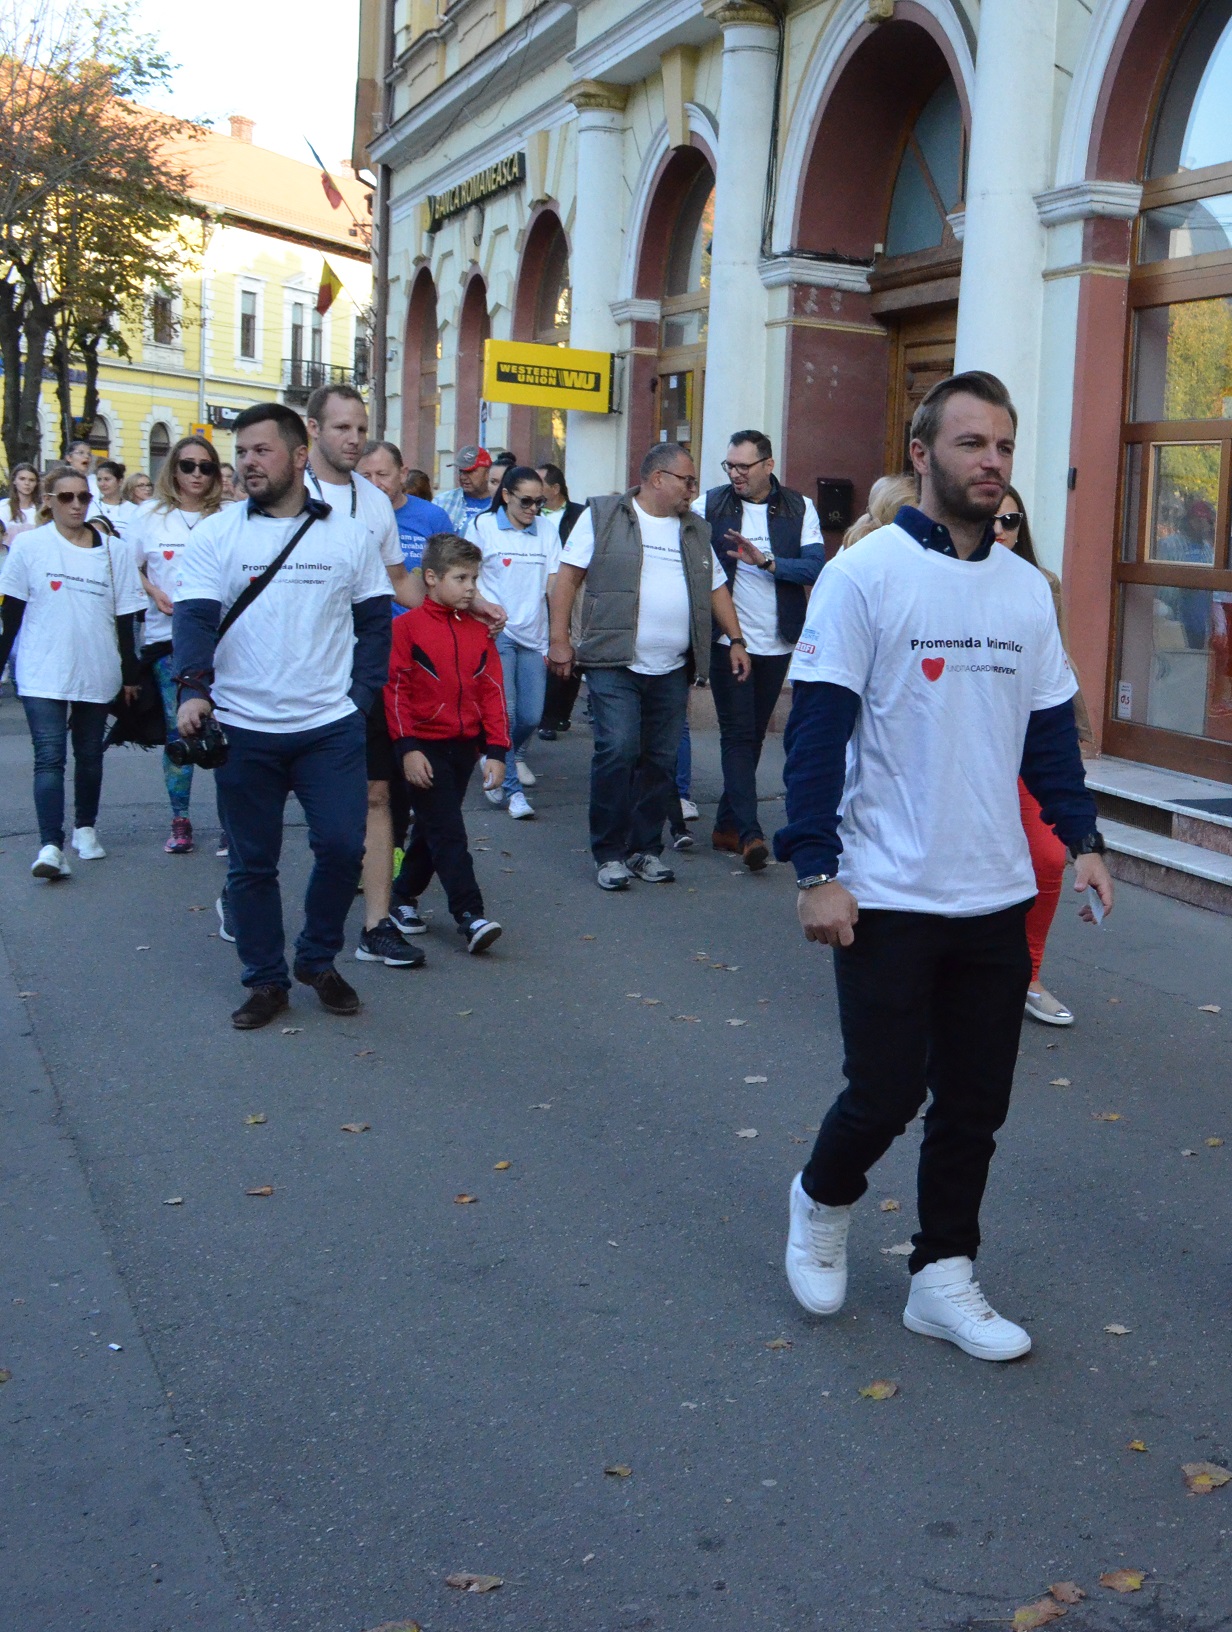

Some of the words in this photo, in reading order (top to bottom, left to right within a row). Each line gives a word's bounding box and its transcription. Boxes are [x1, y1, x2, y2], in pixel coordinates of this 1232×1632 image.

[500, 363, 557, 377] WESTERN
[517, 373, 557, 386] UNION
[562, 370, 596, 390] WU
[242, 563, 293, 571] Promda
[295, 562, 333, 572] Inimilor
